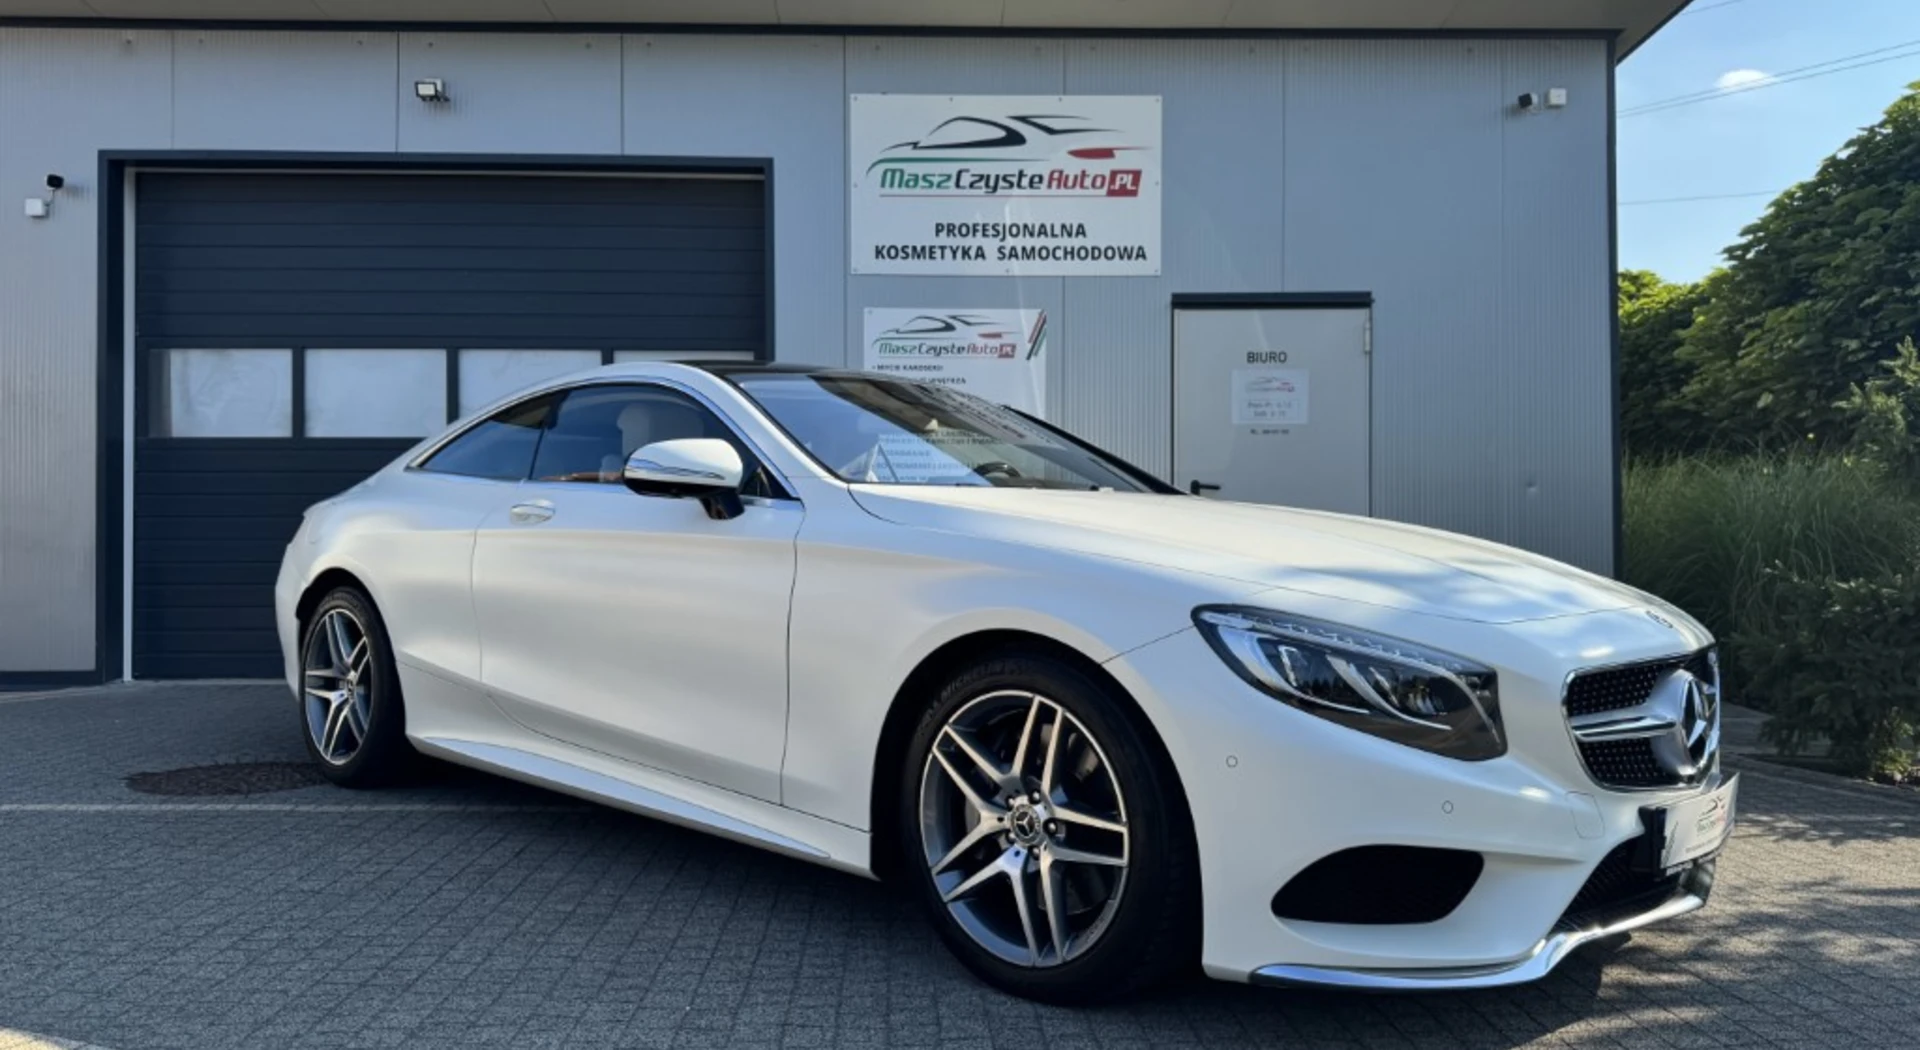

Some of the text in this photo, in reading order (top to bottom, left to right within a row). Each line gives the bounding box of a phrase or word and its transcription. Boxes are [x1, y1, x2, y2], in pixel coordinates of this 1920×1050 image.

[934, 222, 1087, 242] PROFESJONALNA
[874, 245, 1148, 261] KOSMETYKA SAMOCHODOWA
[1246, 351, 1288, 364] BIURO
